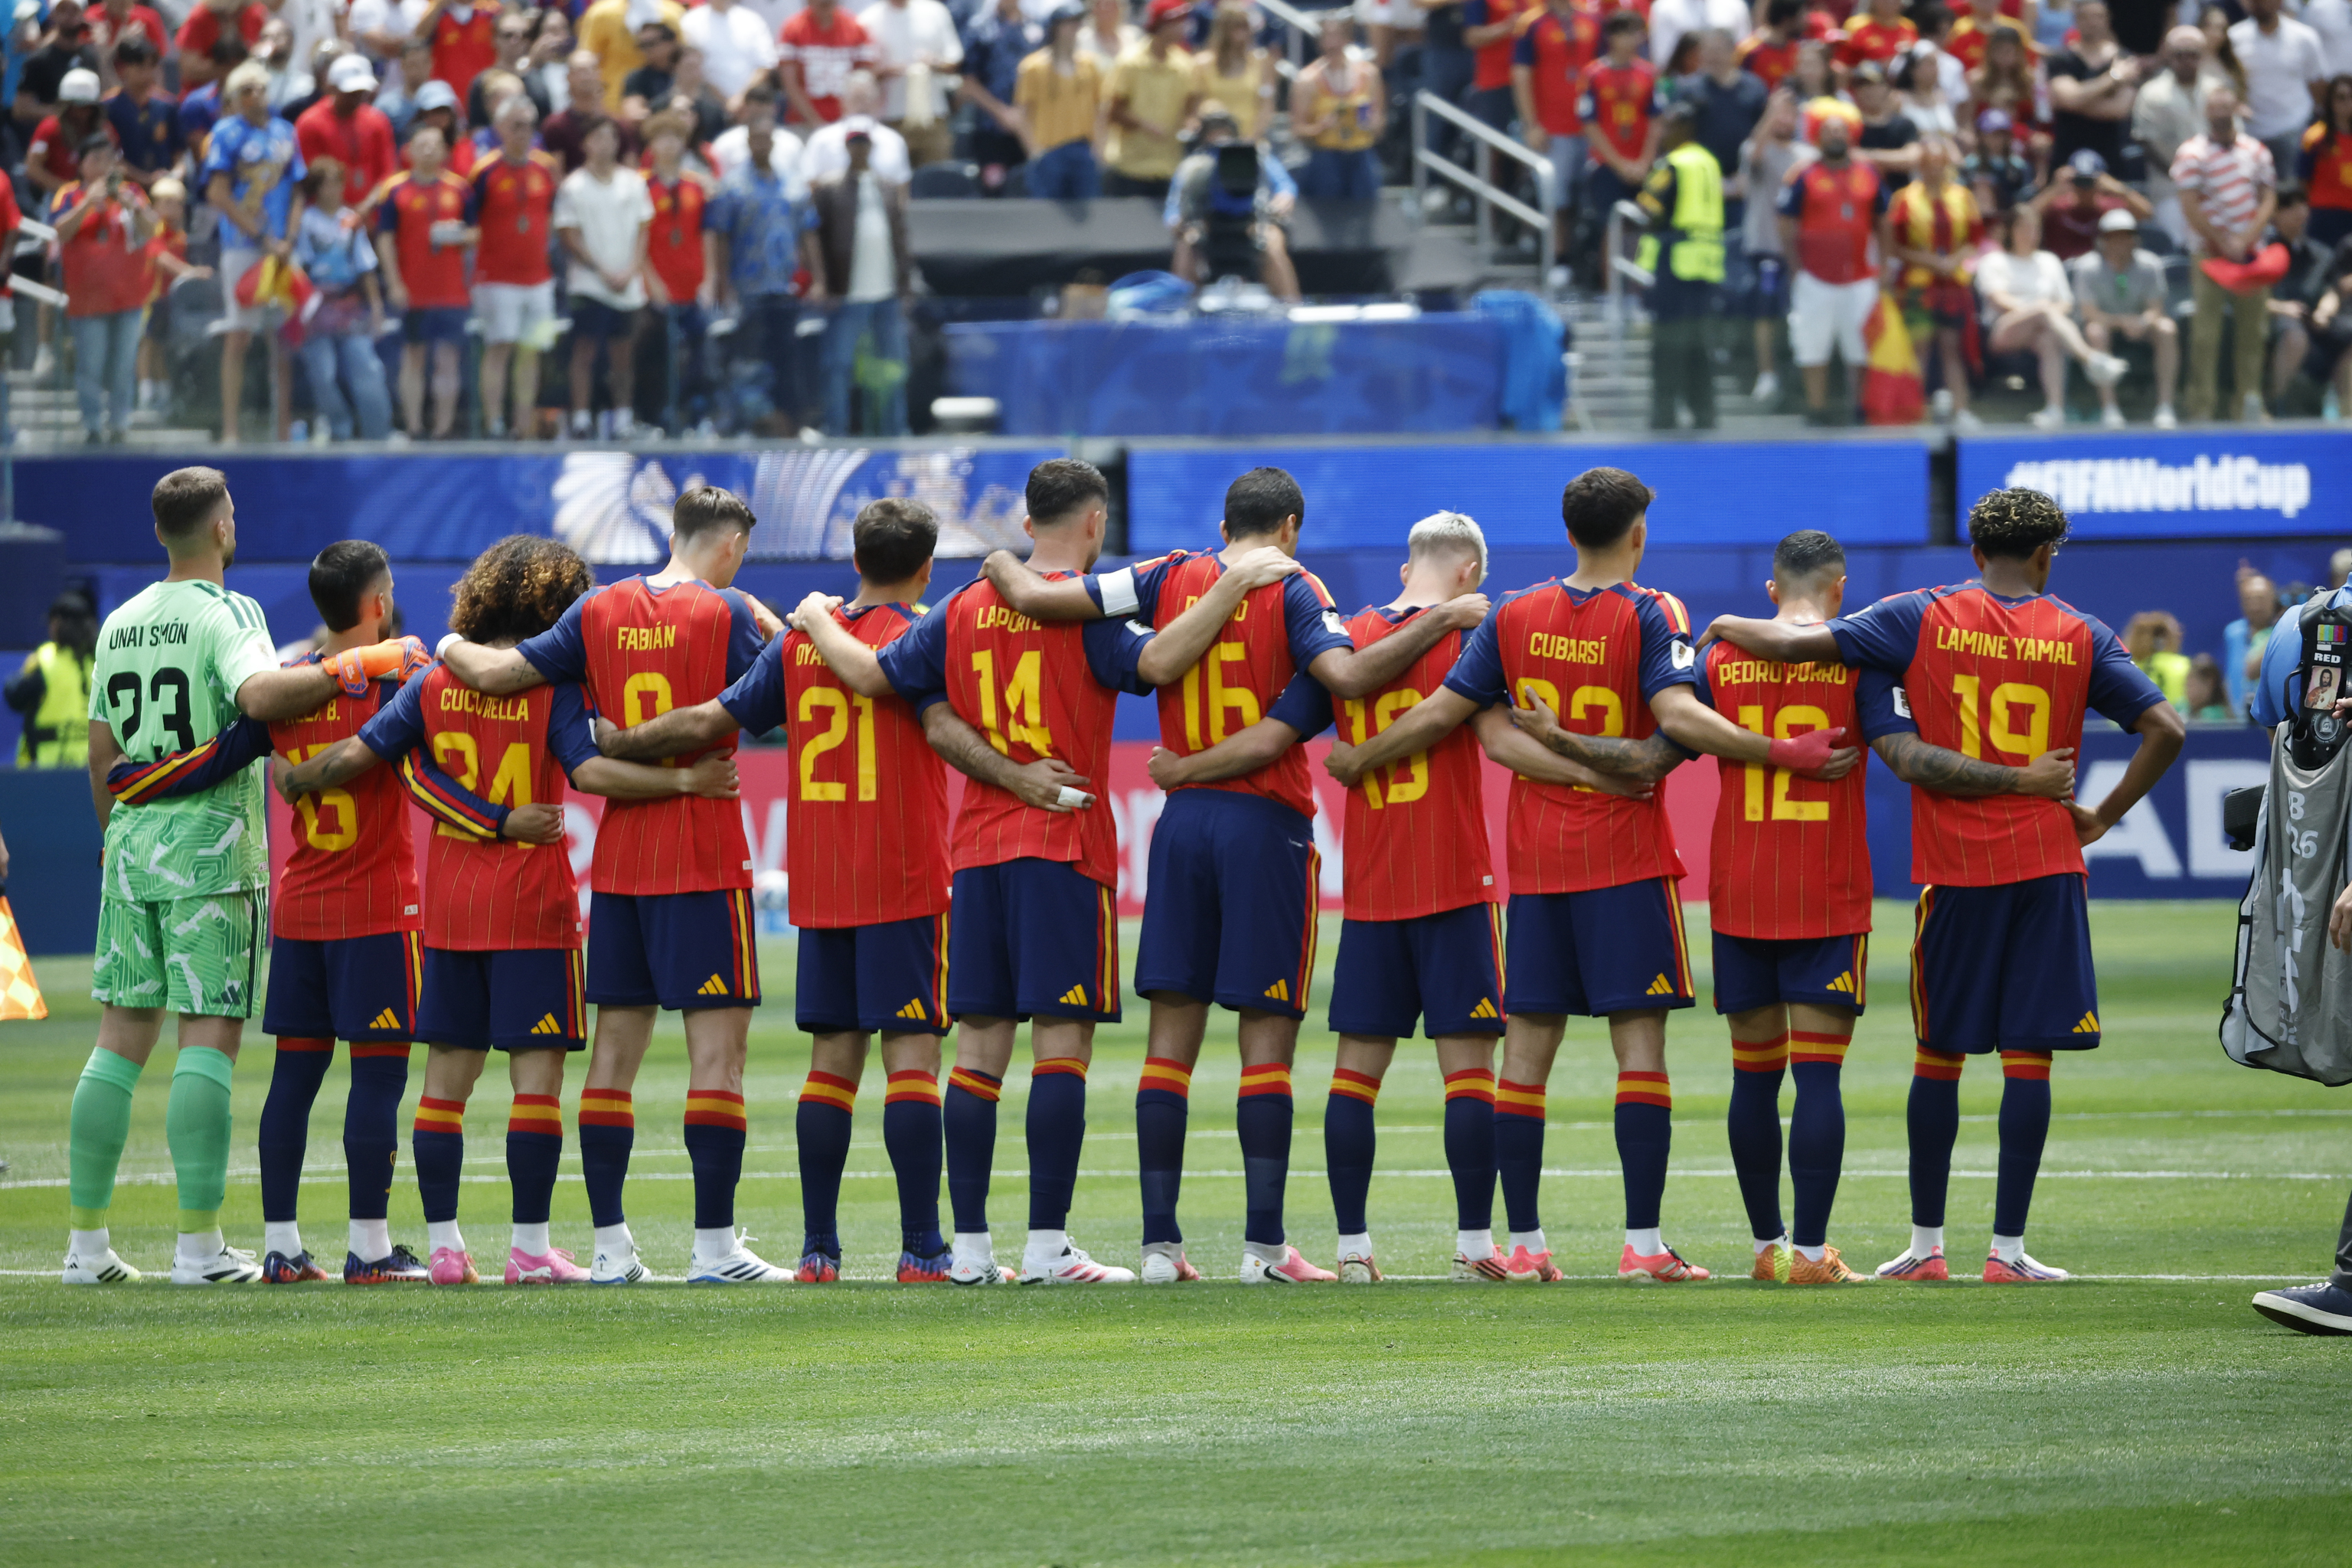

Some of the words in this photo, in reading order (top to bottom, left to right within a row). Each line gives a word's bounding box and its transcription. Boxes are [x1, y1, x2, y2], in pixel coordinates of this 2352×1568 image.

[109, 626, 145, 650] UNAI
[617, 620, 677, 651] FABIÁN
[1530, 632, 1607, 665] CUBARSÍ
[1718, 660, 1784, 687] PEDRO
[1785, 661, 1847, 684] PORRO
[1936, 626, 2008, 660] LAMINE
[2014, 637, 2077, 665] YAMAL
[2314, 652, 2341, 664] RED
[107, 667, 193, 766] 23
[972, 648, 1053, 758] 14
[1183, 642, 1261, 750] 16
[1953, 674, 2050, 766] 19
[433, 731, 536, 849] 24
[799, 686, 877, 802] 21
[1738, 704, 1830, 822] 12
